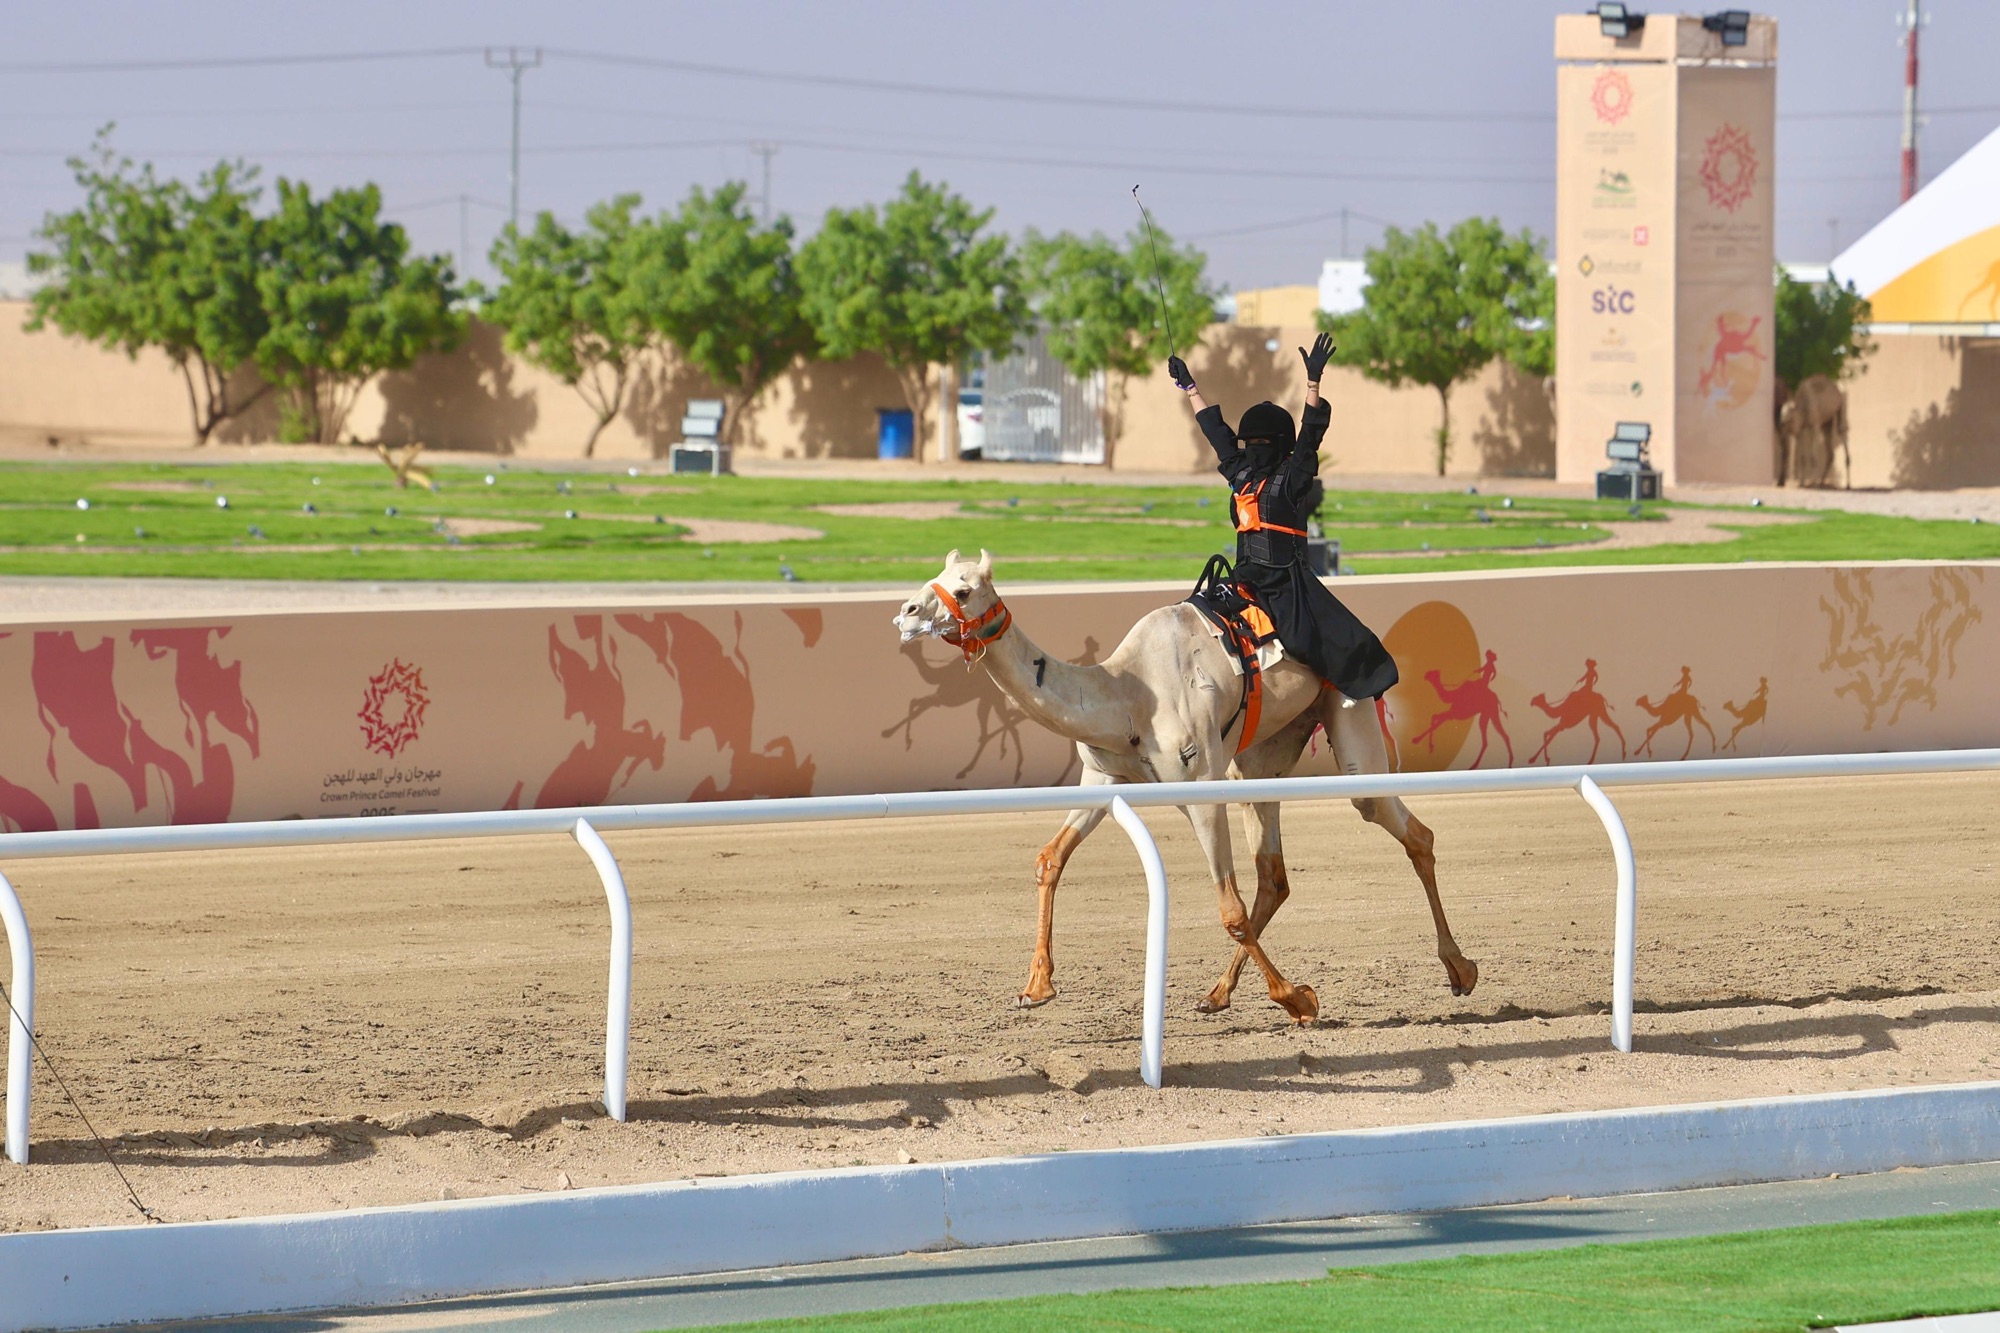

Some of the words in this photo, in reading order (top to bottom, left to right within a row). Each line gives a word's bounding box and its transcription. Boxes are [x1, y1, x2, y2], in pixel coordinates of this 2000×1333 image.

[1592, 285, 1635, 314] stc
[323, 769, 355, 787] للهجن
[356, 768, 383, 785] العهد
[404, 766, 442, 783] مهرجان
[320, 792, 348, 802] Crown
[350, 790, 377, 800] Prince
[378, 788, 405, 799] Camel
[406, 787, 441, 797] Festival
